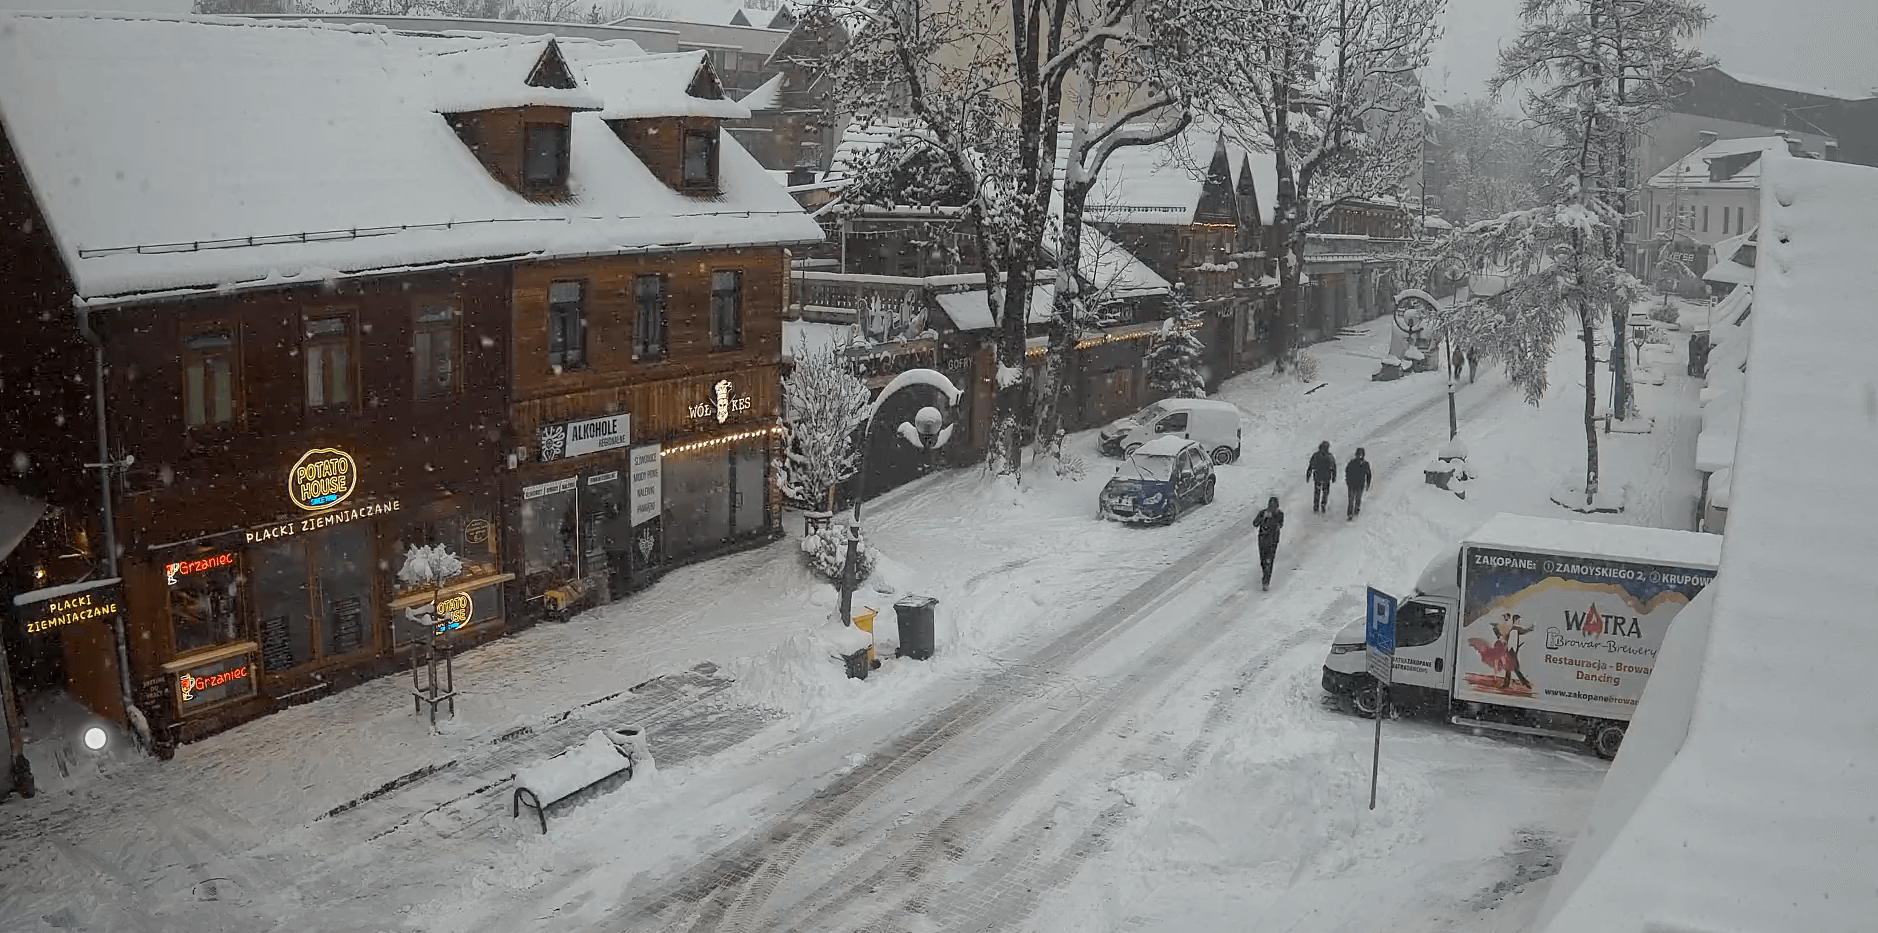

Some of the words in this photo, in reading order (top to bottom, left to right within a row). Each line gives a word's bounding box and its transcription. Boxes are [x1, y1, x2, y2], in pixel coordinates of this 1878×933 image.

[948, 356, 974, 371] GOFRY
[688, 402, 712, 419] WÓŁ
[731, 396, 751, 414] KĘS
[571, 419, 618, 442] ALKOHOLE
[296, 457, 349, 485] POTATO
[300, 475, 348, 501] HOUSE
[246, 522, 295, 544] PLACKI
[301, 500, 401, 532] ZIEMNIACZANE
[178, 553, 233, 575] Grzaniec
[1475, 555, 1537, 570] ZAKOPANE:
[1555, 562, 1635, 580] ZAMOYSKIEGO
[1662, 573, 1714, 587] KRUPÓW
[49, 594, 92, 613] PLACKI
[436, 595, 467, 615] OTATO
[1373, 594, 1390, 631] P
[27, 603, 117, 633] ZIEMNIACZANE
[1564, 603, 1643, 639] WATRA
[1544, 653, 1607, 671] Restauracja
[1615, 661, 1653, 675] Browar
[195, 666, 248, 691] Grzaniec
[1576, 670, 1621, 687] Dancing
